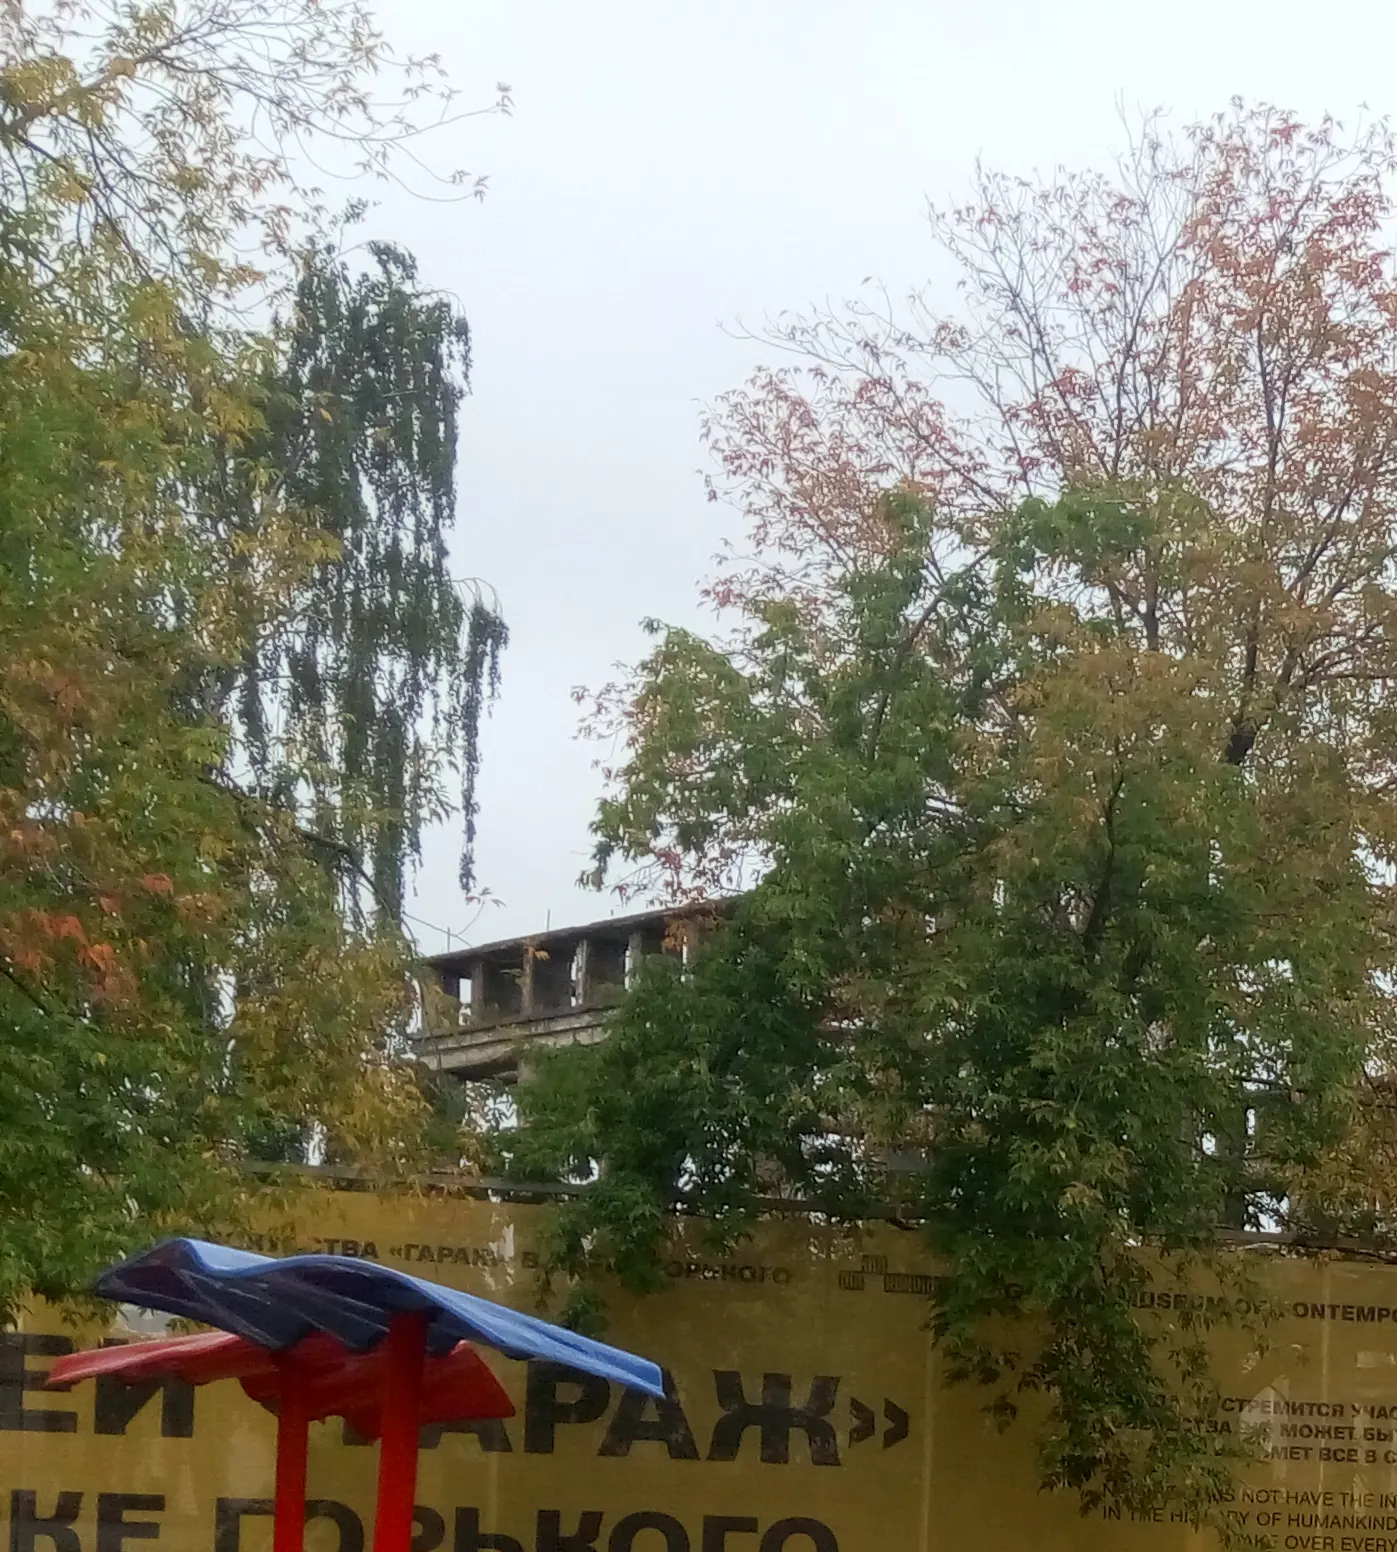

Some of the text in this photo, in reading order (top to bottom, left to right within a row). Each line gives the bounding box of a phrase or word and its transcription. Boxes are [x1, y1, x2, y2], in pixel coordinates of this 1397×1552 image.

[1221, 1398, 1345, 1418] СТРЕМИТСЯ
[1280, 1424, 1355, 1442] МОЖЕТ
[1365, 1450, 1377, 1464] В
[1242, 1488, 1281, 1505] NOT
[1286, 1490, 1334, 1508] HAVE
[1340, 1493, 1374, 1509] THE
[1102, 1505, 1121, 1522] IN
[1256, 1511, 1282, 1527] OF
[1284, 1535, 1335, 1552] OVER
